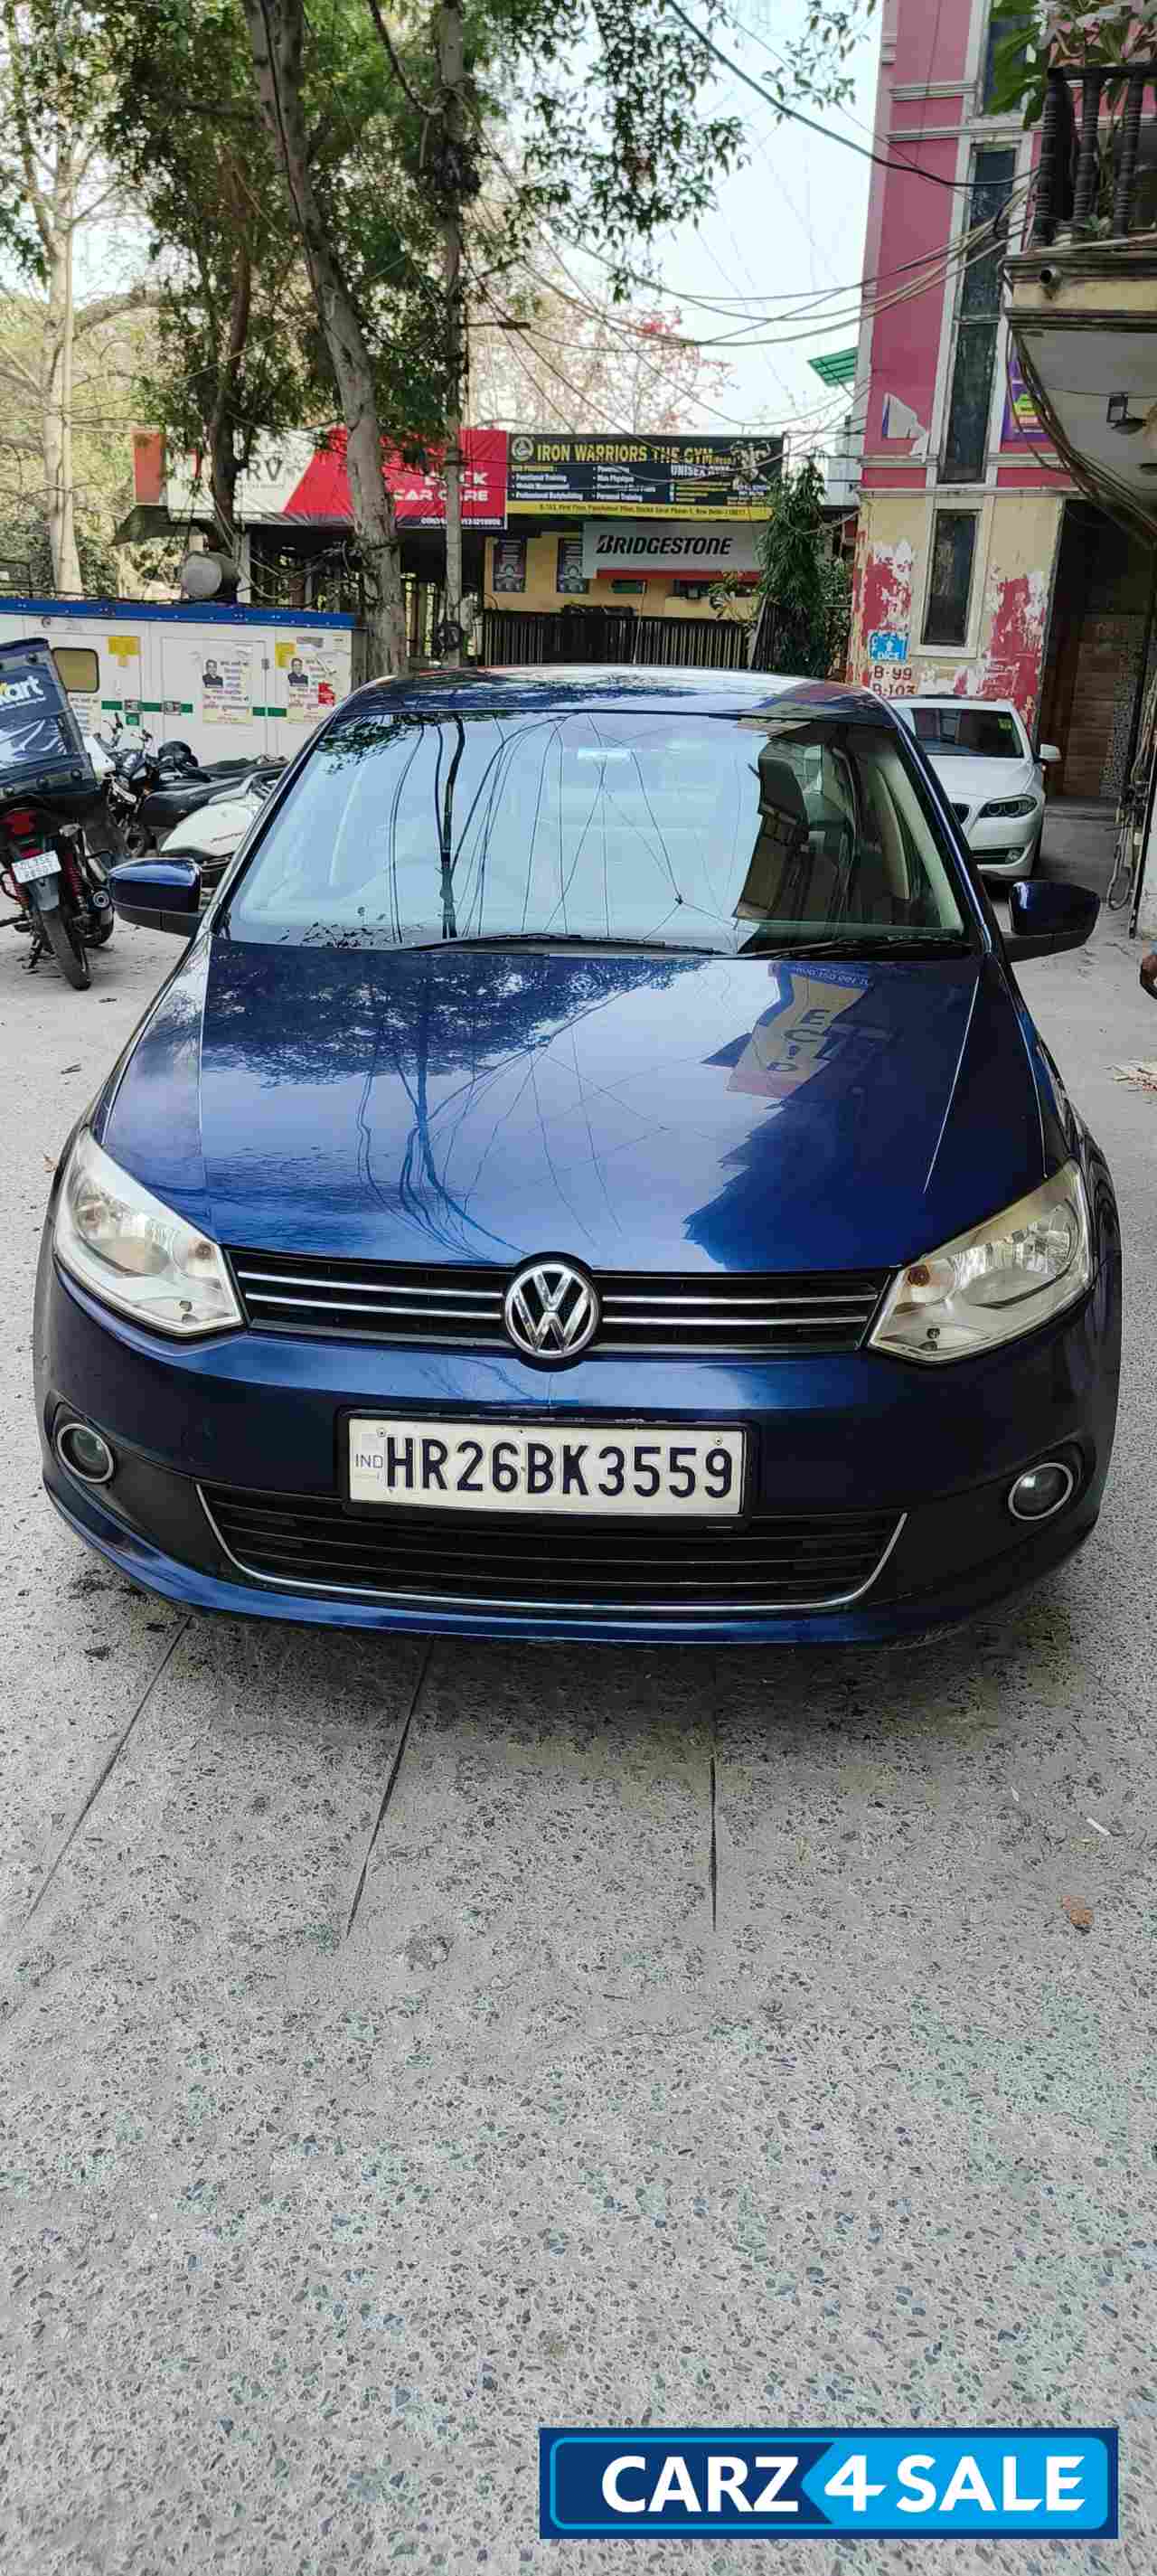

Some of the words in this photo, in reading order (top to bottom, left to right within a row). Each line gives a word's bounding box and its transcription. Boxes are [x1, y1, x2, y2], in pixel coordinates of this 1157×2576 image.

[536, 443, 570, 462] IRON
[574, 443, 648, 462] WARRIORS
[651, 446, 681, 464] THE
[683, 447, 712, 465] GYM
[437, 488, 489, 503] CRE
[596, 534, 734, 555] BRIDGESTONE
[354, 1453, 383, 1468] IND
[386, 1436, 733, 1499] HR26BK3559
